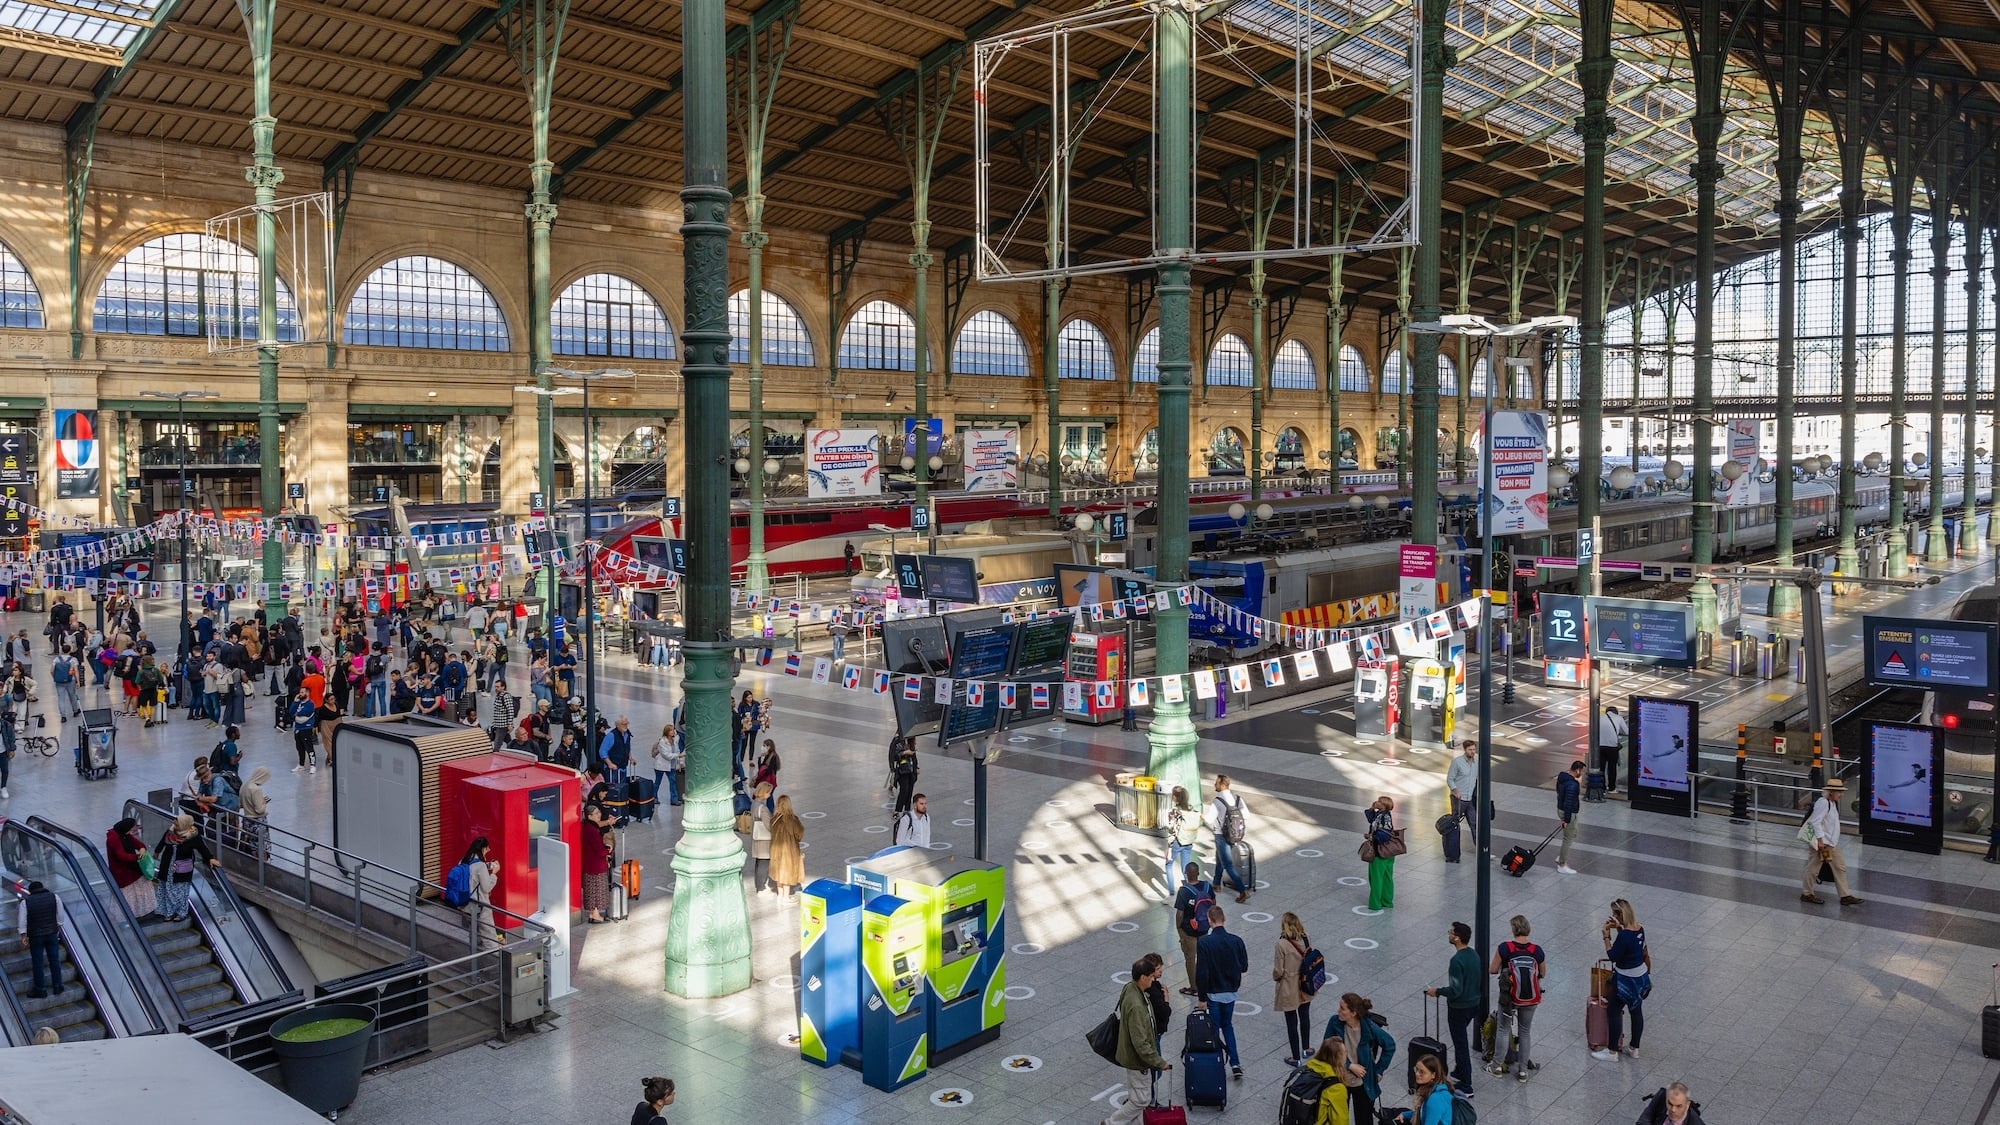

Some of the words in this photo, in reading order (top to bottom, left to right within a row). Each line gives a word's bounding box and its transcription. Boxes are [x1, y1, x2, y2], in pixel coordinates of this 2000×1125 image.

[1496, 439, 1514, 447] VOUS
[1514, 438, 1530, 447] ÊTES
[1530, 438, 1535, 446] À
[1504, 452, 1522, 460] LIEUS
[1496, 464, 1534, 475] D'IMAGINER
[1500, 479, 1514, 488] SON
[1514, 478, 1530, 487] PRIX
[6, 486, 16, 498] P
[536, 499, 542, 507] 8
[668, 504, 675, 514] 9
[915, 514, 927, 525] 10
[1114, 522, 1124, 534] 11
[1828, 528, 1834, 536] R
[529, 543, 534, 553] 8
[1581, 540, 1591, 556] 12
[677, 554, 684, 566] 9
[902, 572, 916, 585] 10
[1019, 586, 1032, 596] en
[1550, 619, 1576, 638] 12
